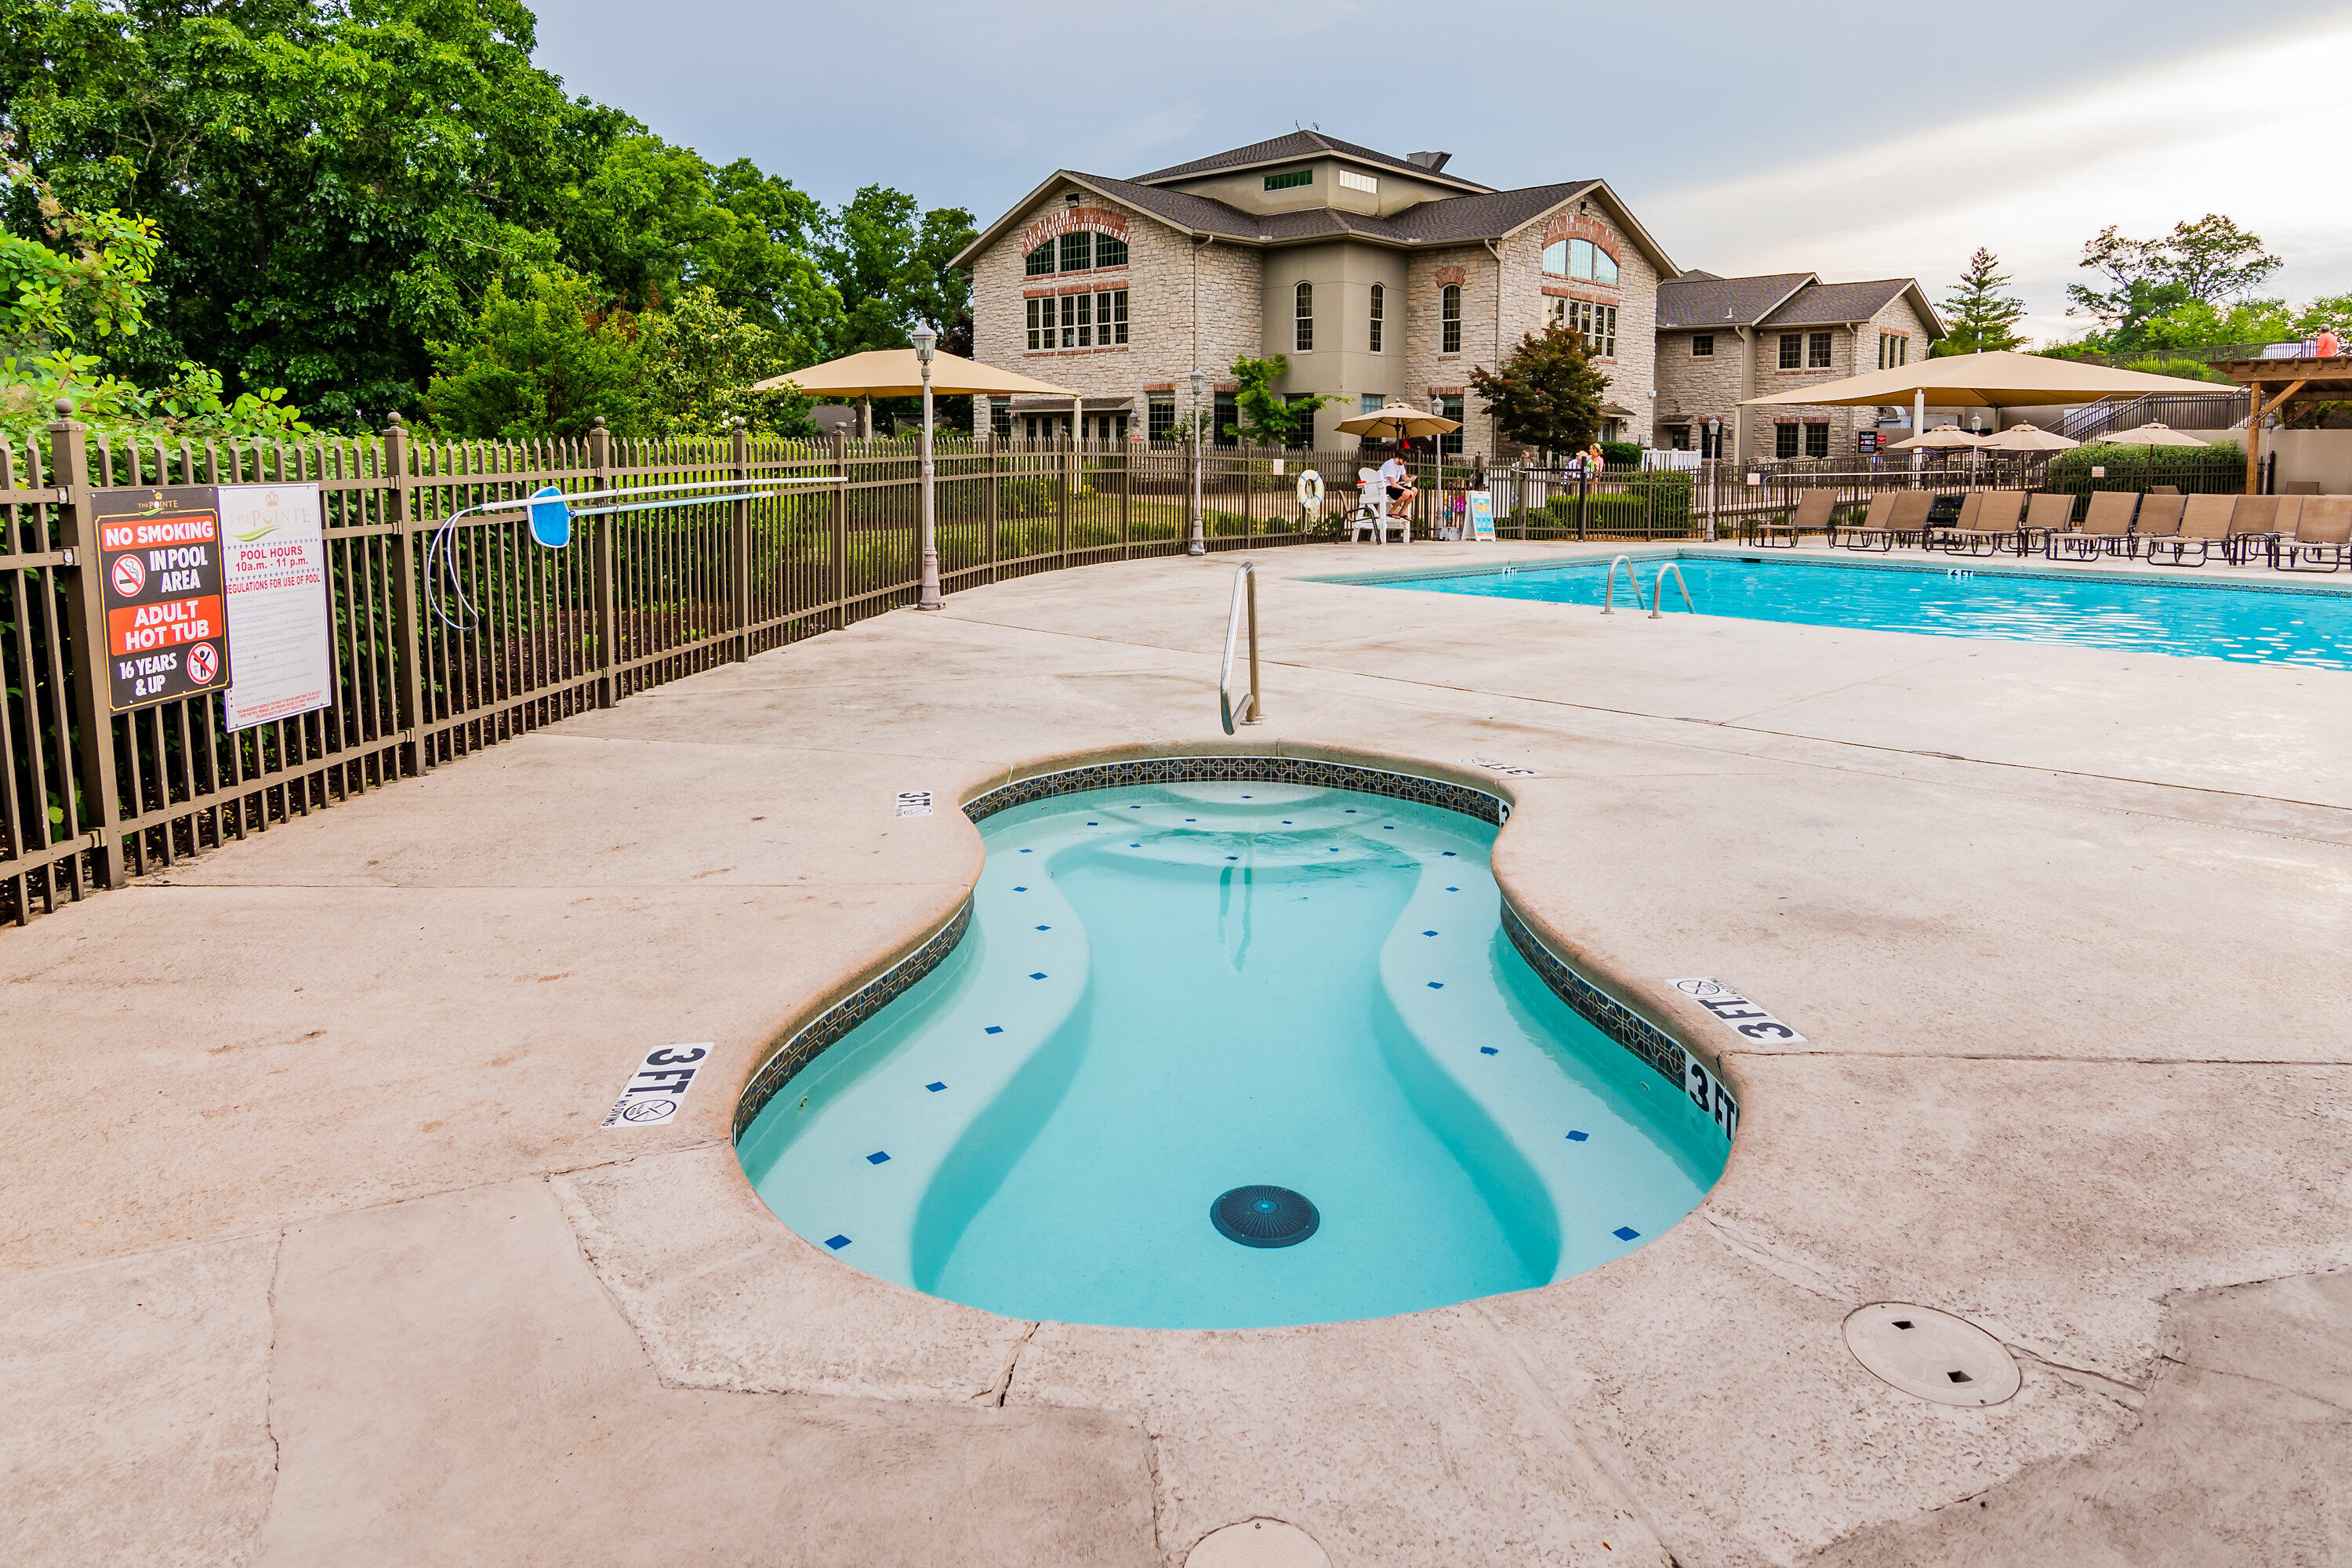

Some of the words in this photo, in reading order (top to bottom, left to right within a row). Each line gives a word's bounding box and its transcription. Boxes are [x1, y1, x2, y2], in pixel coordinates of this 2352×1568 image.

[252, 508, 310, 527] POINTE
[105, 527, 133, 546] NO
[137, 521, 213, 543] SMOKING
[149, 550, 166, 572] IN
[168, 546, 208, 570] POOL
[235, 561, 267, 572] 10a.m.
[277, 557, 286, 568] 11
[240, 550, 267, 561] POOL
[270, 546, 303, 558] HOURS
[161, 569, 201, 593] AREA
[270, 579, 282, 589] FOR
[283, 577, 295, 587] USE
[296, 575, 304, 585] OF
[305, 574, 321, 583] POOL
[134, 601, 198, 627] ADULT
[125, 626, 167, 651] HOT
[171, 619, 209, 641] TUB
[119, 661, 135, 680] 16
[136, 652, 177, 676] YEARS
[135, 679, 147, 696] &
[147, 675, 166, 693] UP
[1738, 1022, 1794, 1038] 3
[646, 1048, 706, 1065] 3
[1690, 1063, 1710, 1112] 3
[1715, 1080, 1735, 1142] FT
